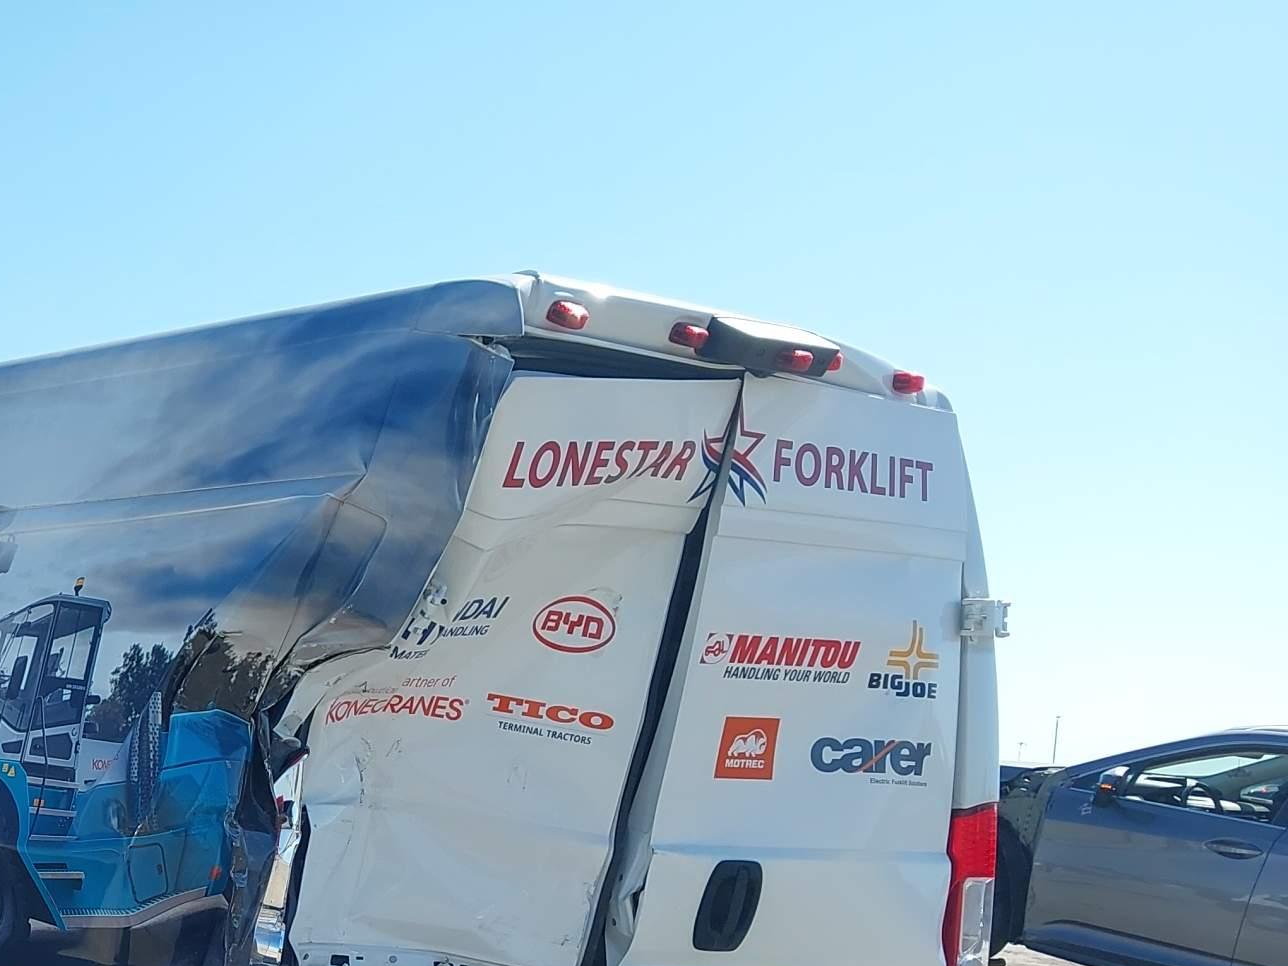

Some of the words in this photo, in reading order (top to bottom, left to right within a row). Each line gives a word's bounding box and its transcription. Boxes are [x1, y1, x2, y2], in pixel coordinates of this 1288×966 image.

[502, 440, 696, 488] LONESTAR
[773, 439, 934, 502] FORKLIFT
[541, 610, 605, 640] BYD
[729, 634, 861, 669] MANITOU
[402, 676, 440, 688] artner
[442, 675, 457, 687] of
[723, 666, 781, 681] HANDLING
[782, 669, 812, 682] YOUR
[813, 670, 850, 684] WORLD
[867, 673, 905, 691] BIG
[896, 681, 938, 699] JOE
[487, 693, 614, 730] TICO
[498, 720, 543, 737] TERMINAL
[546, 729, 592, 745] TRACTORS
[725, 758, 765, 769] MOTREC
